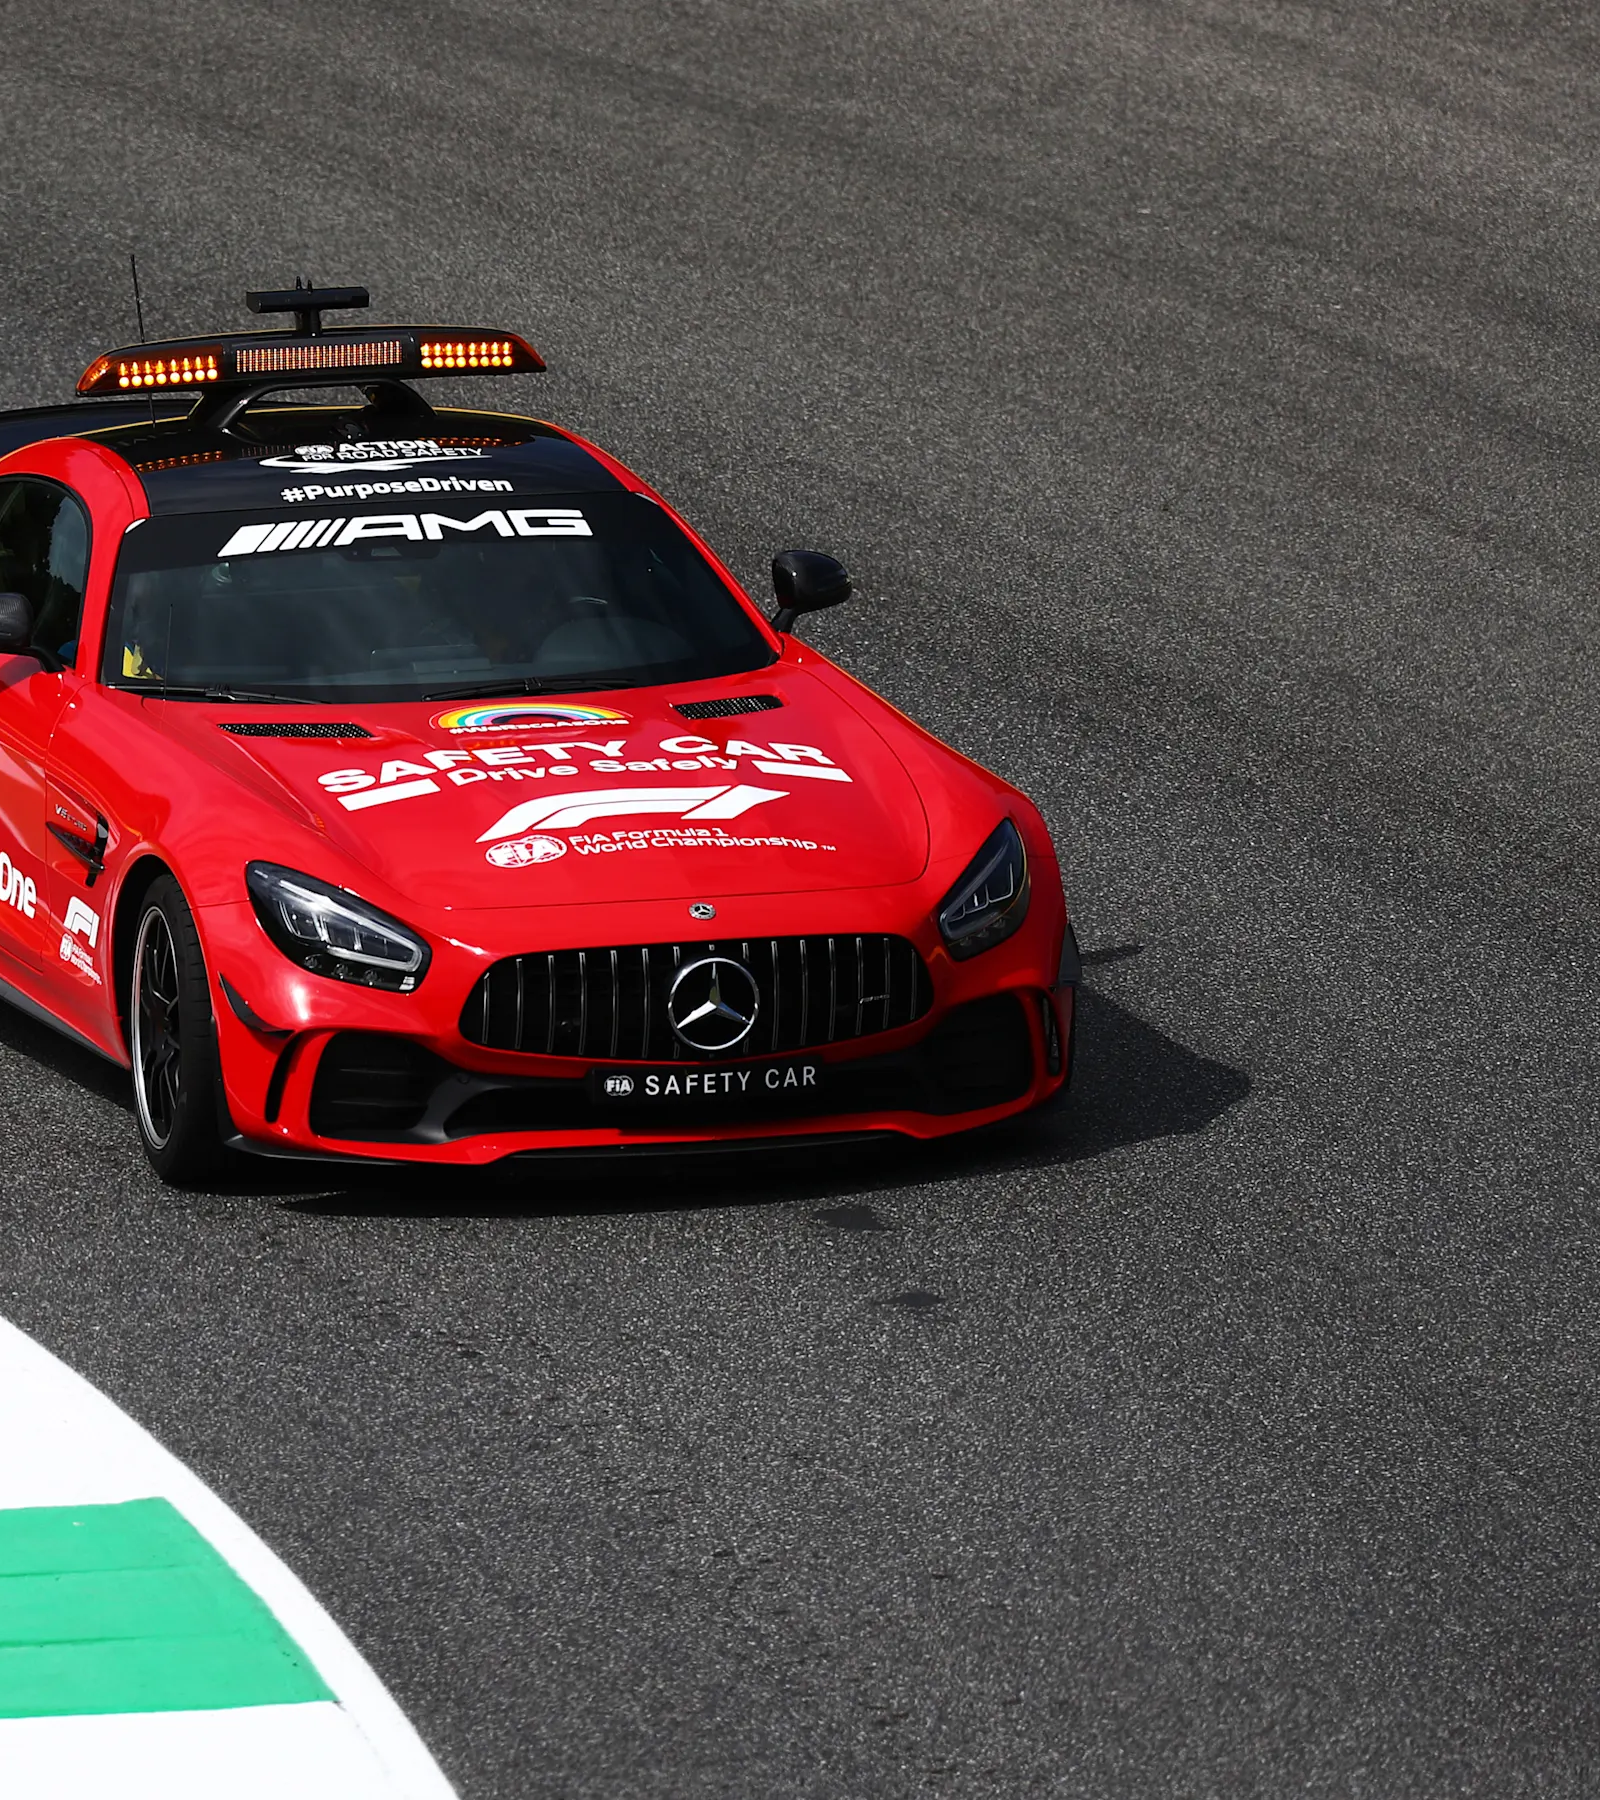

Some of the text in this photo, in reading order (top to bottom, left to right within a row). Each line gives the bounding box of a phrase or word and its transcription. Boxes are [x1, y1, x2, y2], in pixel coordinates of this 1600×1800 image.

[302, 448, 483, 462] FOR ROAD SAFETY
[339, 439, 440, 453] ACTION
[281, 476, 514, 503] #PurposeDriven
[334, 509, 593, 547] AMG
[449, 719, 630, 734] #WeRaceAsOne
[317, 734, 835, 793] SAFETY CAR
[446, 755, 738, 787] Drive Safely
[567, 827, 729, 846] FIA Formula 1
[572, 838, 649, 855] World
[650, 836, 818, 850] Championship
[644, 1070, 751, 1096] SAFETY
[764, 1065, 817, 1089] CAR
